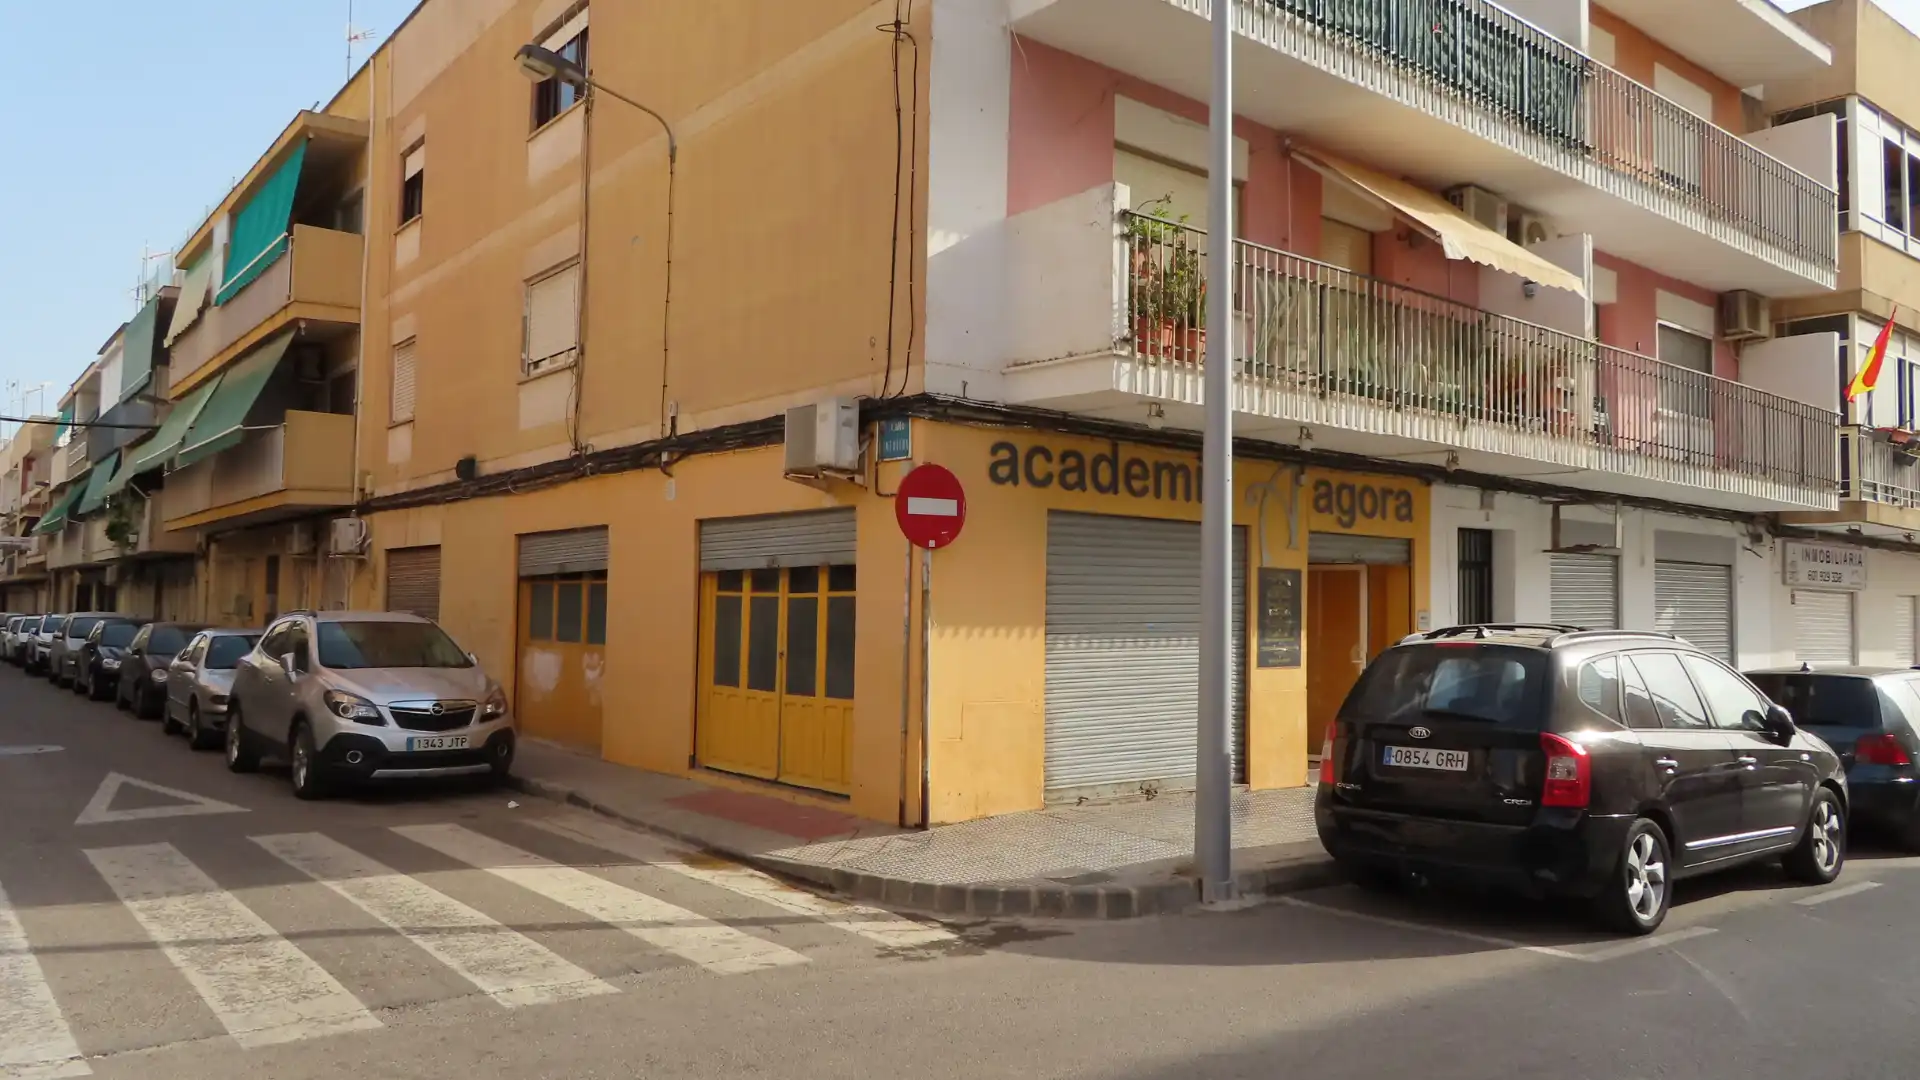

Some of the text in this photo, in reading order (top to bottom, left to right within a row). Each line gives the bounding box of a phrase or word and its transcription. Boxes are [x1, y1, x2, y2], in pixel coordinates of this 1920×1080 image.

[990, 440, 1203, 504] academi
[1312, 478, 1414, 529] agora
[1801, 547, 1863, 566] INMOBILIARIA
[416, 737, 468, 748] 1343 JTP
[1395, 749, 1465, 769] 0854 GRH
